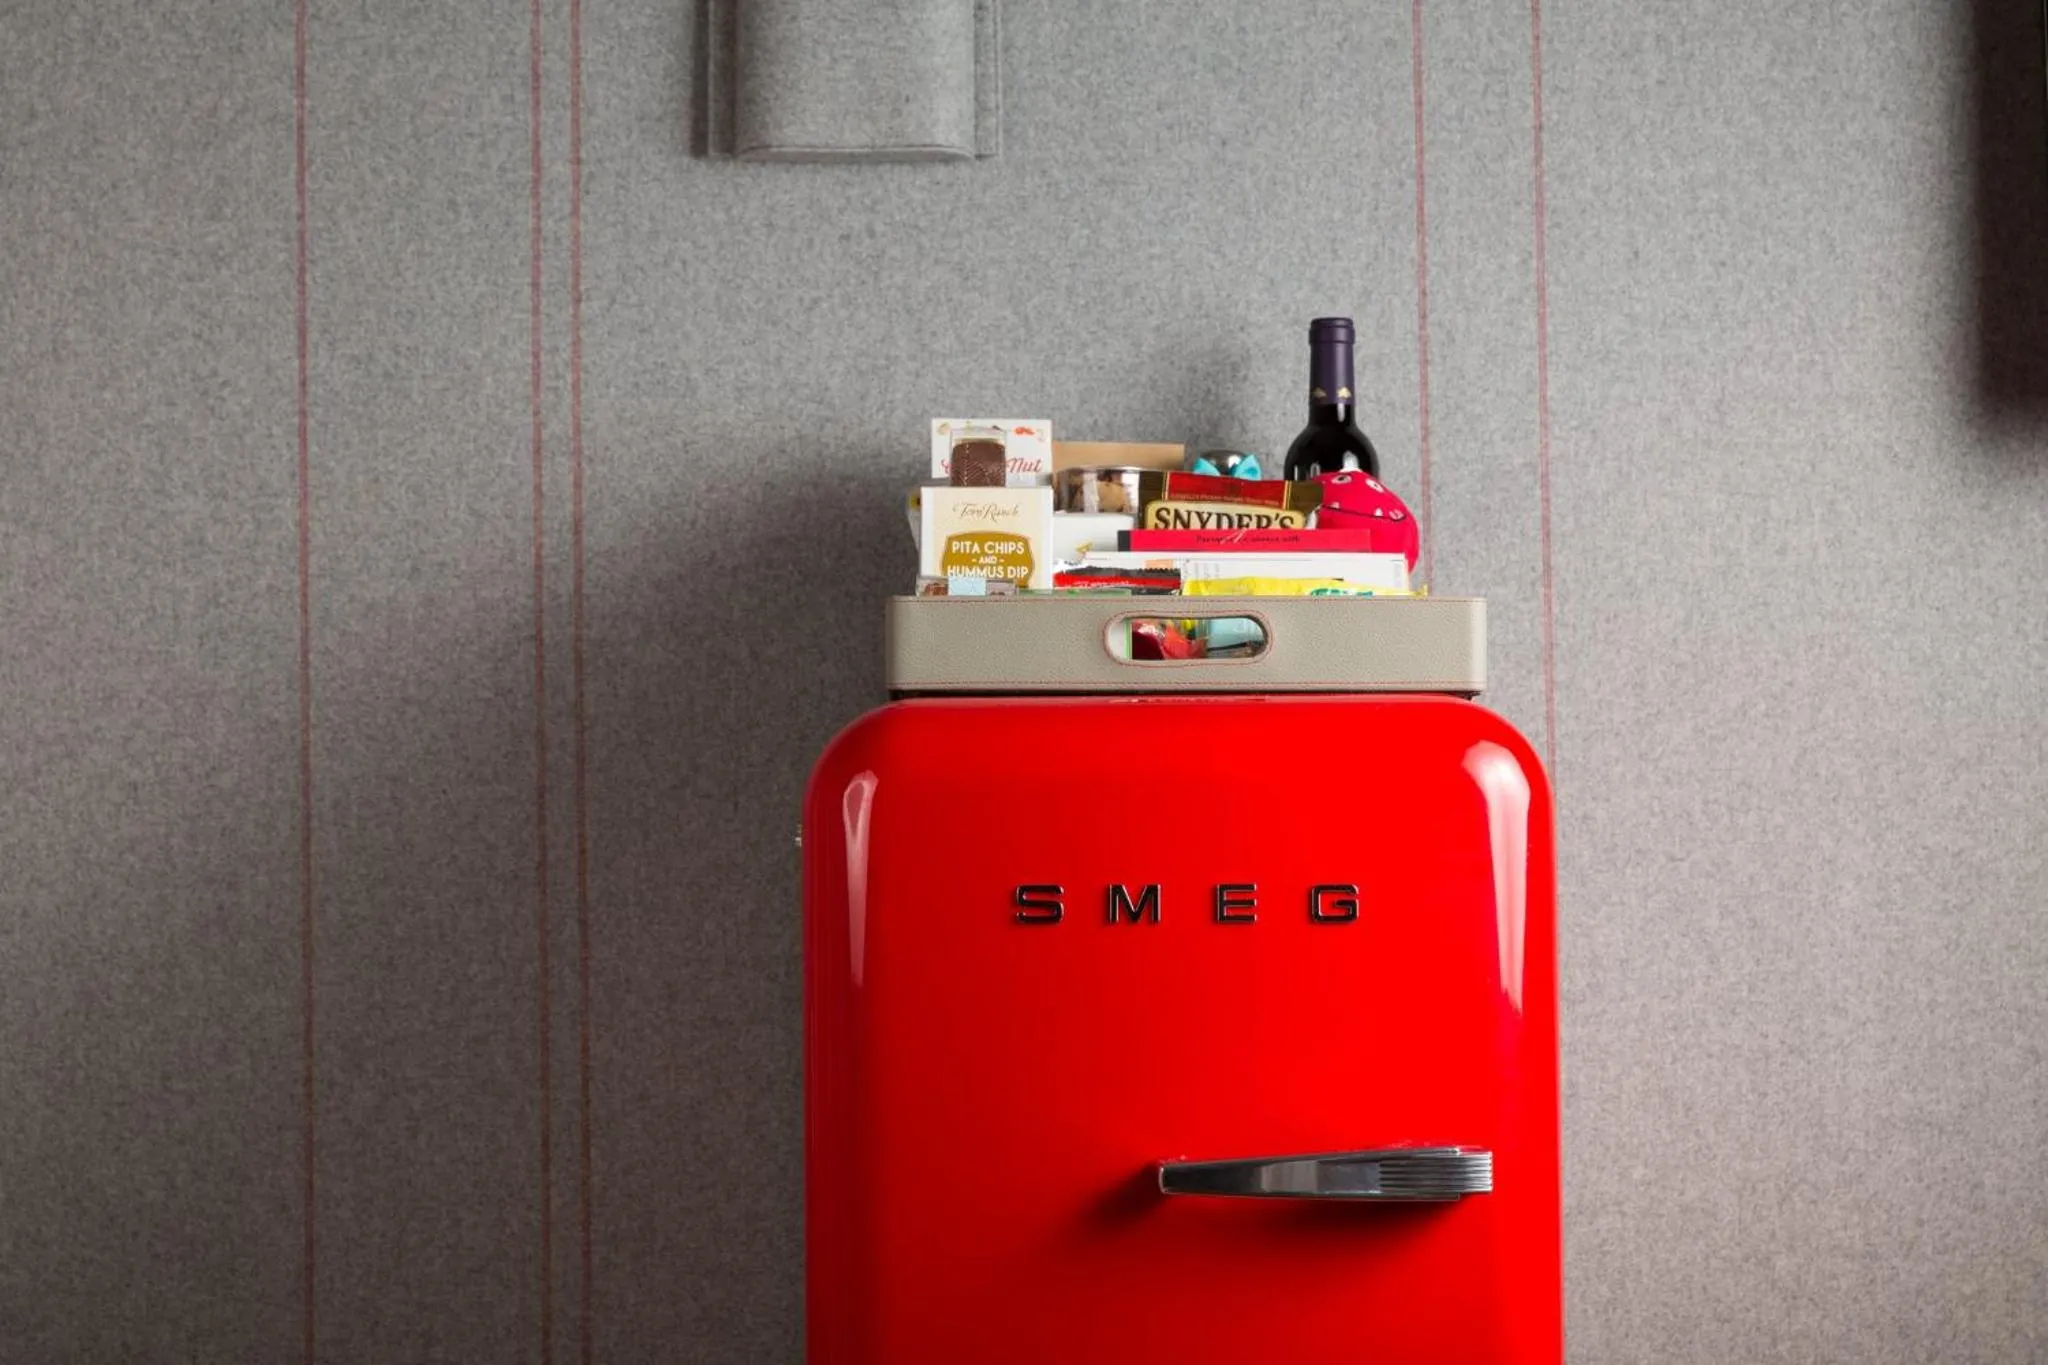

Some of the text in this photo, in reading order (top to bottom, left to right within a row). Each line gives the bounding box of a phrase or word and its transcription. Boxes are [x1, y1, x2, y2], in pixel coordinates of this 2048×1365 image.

[1154, 507, 1295, 529] SNYDER'S
[952, 541, 1025, 554] PITA CHIPS
[978, 555, 997, 564] AND
[947, 565, 1029, 578] HUMMUS DIP
[1014, 883, 1360, 924] SMEG
